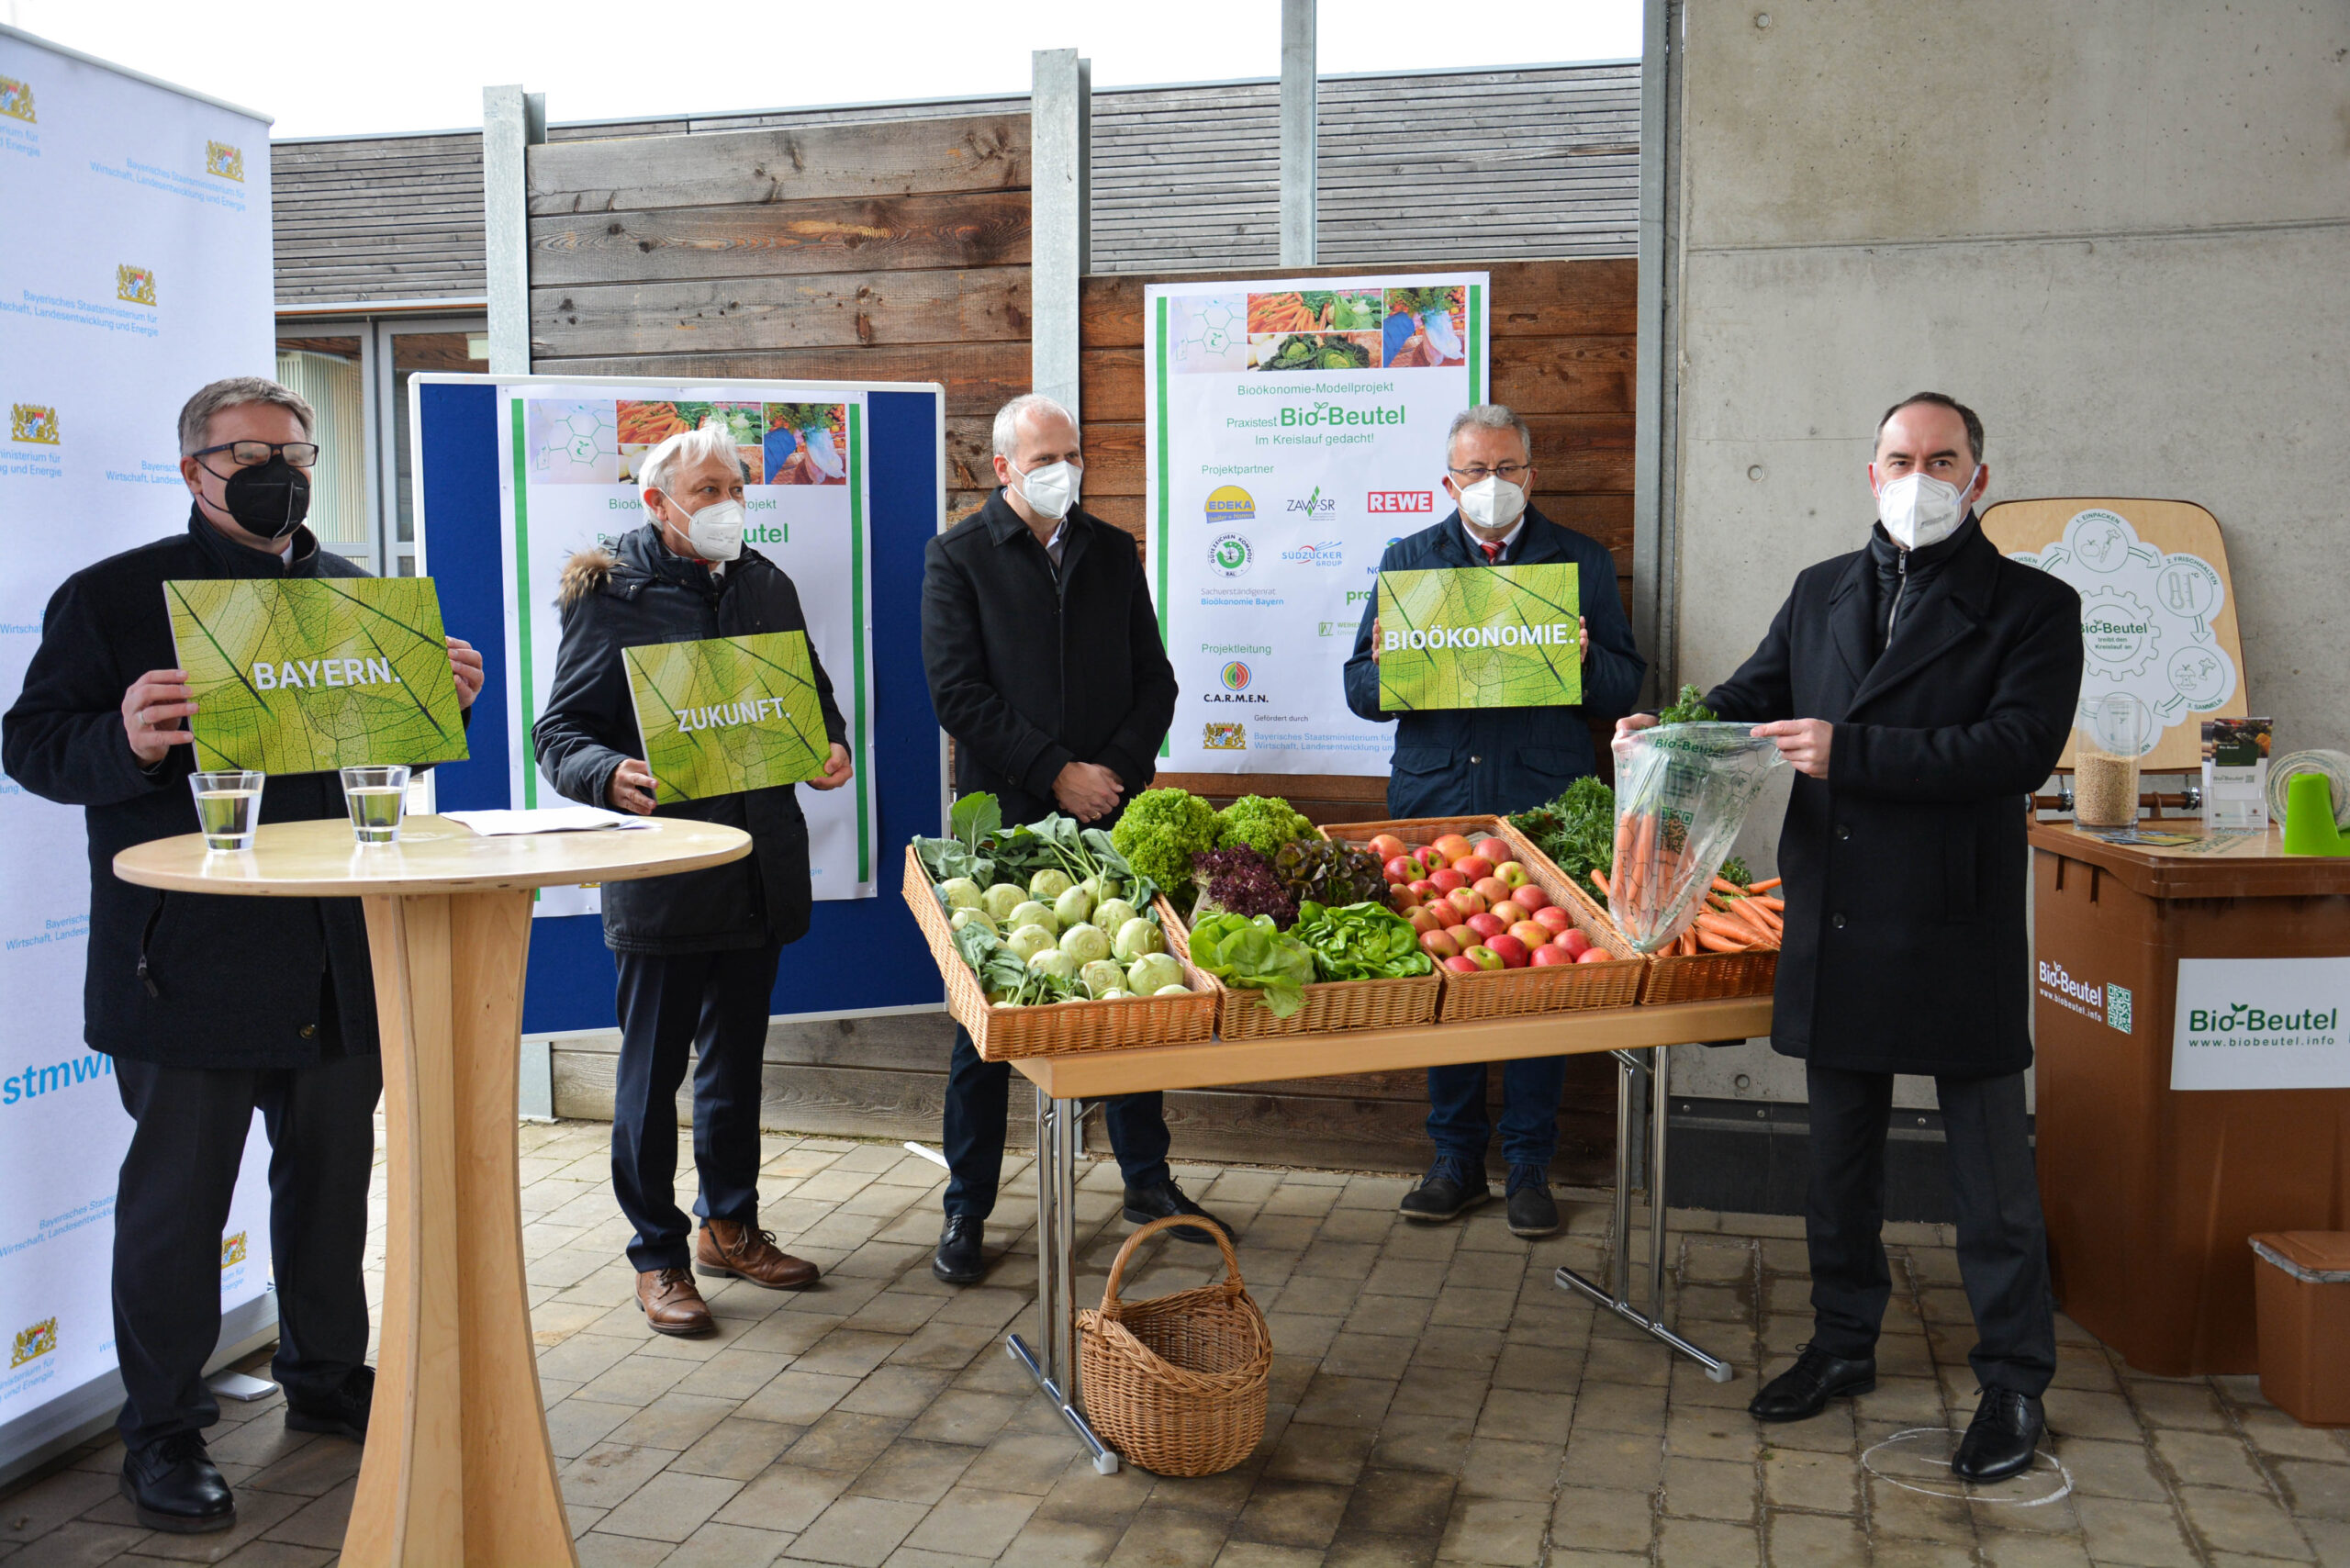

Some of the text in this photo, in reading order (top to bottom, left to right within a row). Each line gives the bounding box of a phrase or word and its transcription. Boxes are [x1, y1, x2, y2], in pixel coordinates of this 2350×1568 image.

[23, 289, 75, 309] Bayerisches
[77, 299, 148, 321] Staatsministerium
[34, 307, 114, 331] Landesentwicklung
[116, 320, 129, 331] und
[131, 322, 159, 338] Energie
[1237, 381, 1394, 396] Bioökonomie-Modellprojekt
[1226, 403, 1405, 429] Praxistest Bio-Beutel
[1255, 433, 1375, 446] Im Kreislauf gedacht!
[49, 452, 61, 464] für
[11, 464, 28, 475] und
[29, 465, 62, 478] Energie
[1202, 464, 1274, 476] Projektpartner
[1208, 500, 1252, 510] EDEKA
[1287, 498, 1336, 512] ZAW-SR
[1370, 493, 1431, 511] REWE
[2082, 512, 2121, 524] EINPACKEN
[1281, 550, 1342, 560] SÜDZUCKER
[2174, 556, 2219, 586] FRISCHHALTEN
[1201, 588, 1276, 597] Sachverständigenrat
[1201, 597, 1284, 607] Bioökonomie Bayern
[1383, 623, 1575, 652] BIOÖKONOMIE.
[1202, 644, 1271, 655] Projektleitung
[252, 656, 402, 689] BAYERN.
[1203, 693, 1269, 703] C.A.R.M.E.N.
[2194, 698, 2223, 710] SAMMELN
[674, 697, 790, 733] ZUKUNFT.
[1254, 733, 1393, 742] Bayerisches Staatsministerium für
[1301, 743, 1380, 752] Landesentwicklung
[2039, 960, 2101, 1008] Bio-Beutel
[2039, 988, 2102, 1022] www.biobeutel.info
[2189, 1003, 2337, 1032] Bio-Beutel
[2189, 1036, 2334, 1047] www.biobeutel.info
[3, 1051, 112, 1105] stmwi
